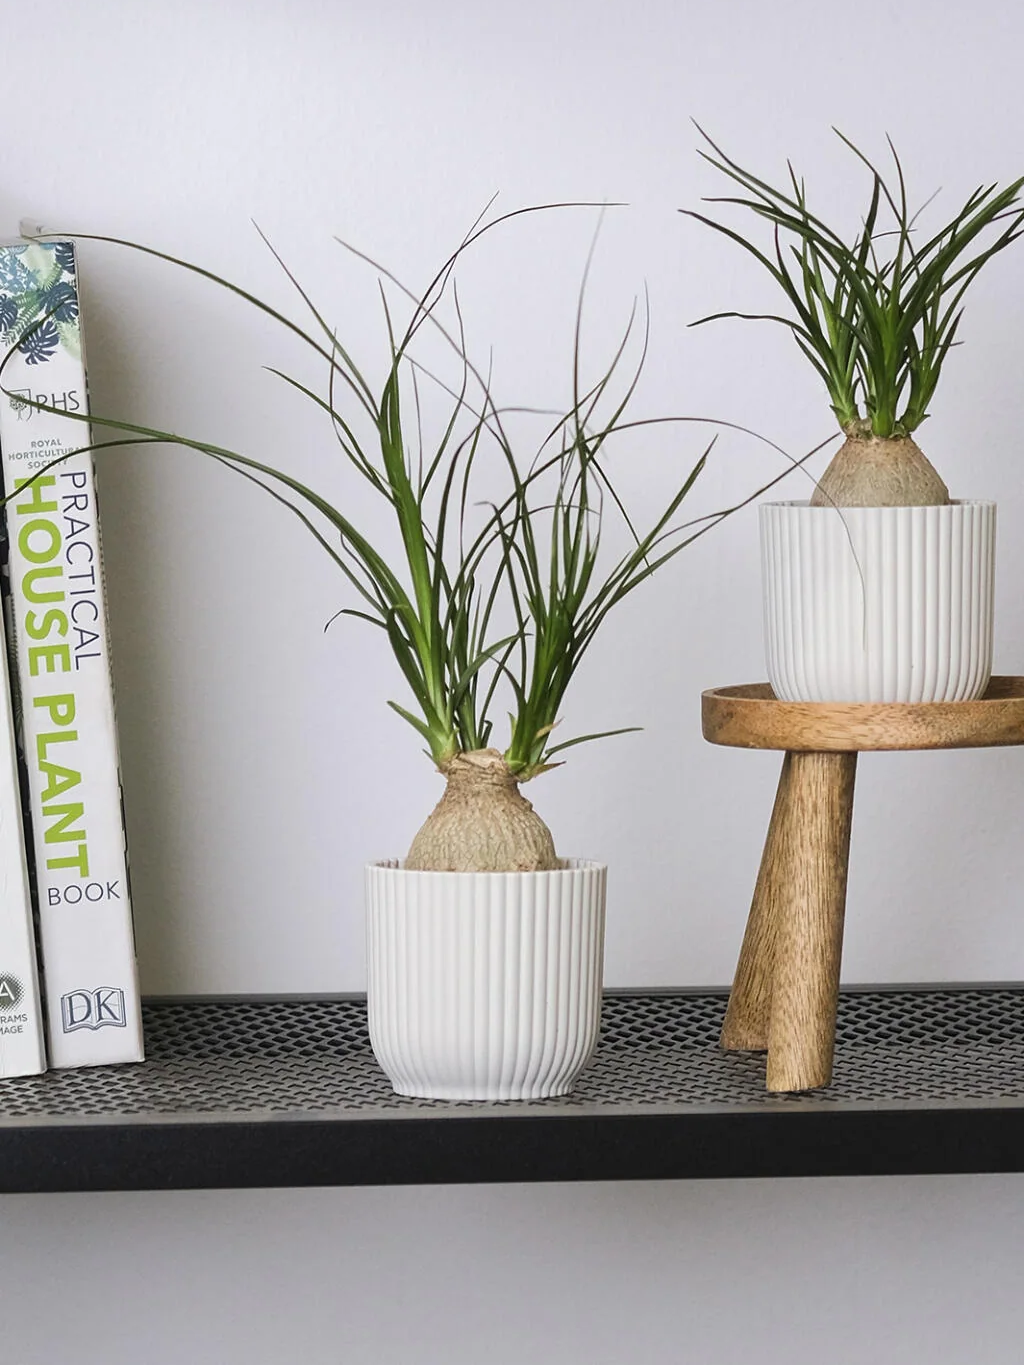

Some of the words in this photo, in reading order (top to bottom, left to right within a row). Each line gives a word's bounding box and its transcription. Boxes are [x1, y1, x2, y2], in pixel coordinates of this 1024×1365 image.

[36, 390, 80, 414] RHS
[30, 438, 62, 449] ROYAL
[14, 475, 72, 677] HOUSE
[60, 471, 101, 671] PRACTICAL
[33, 693, 89, 878] PLANT
[47, 880, 120, 906] BOOK
[0, 1013, 28, 1024] RAMS
[66, 989, 121, 1027] DK
